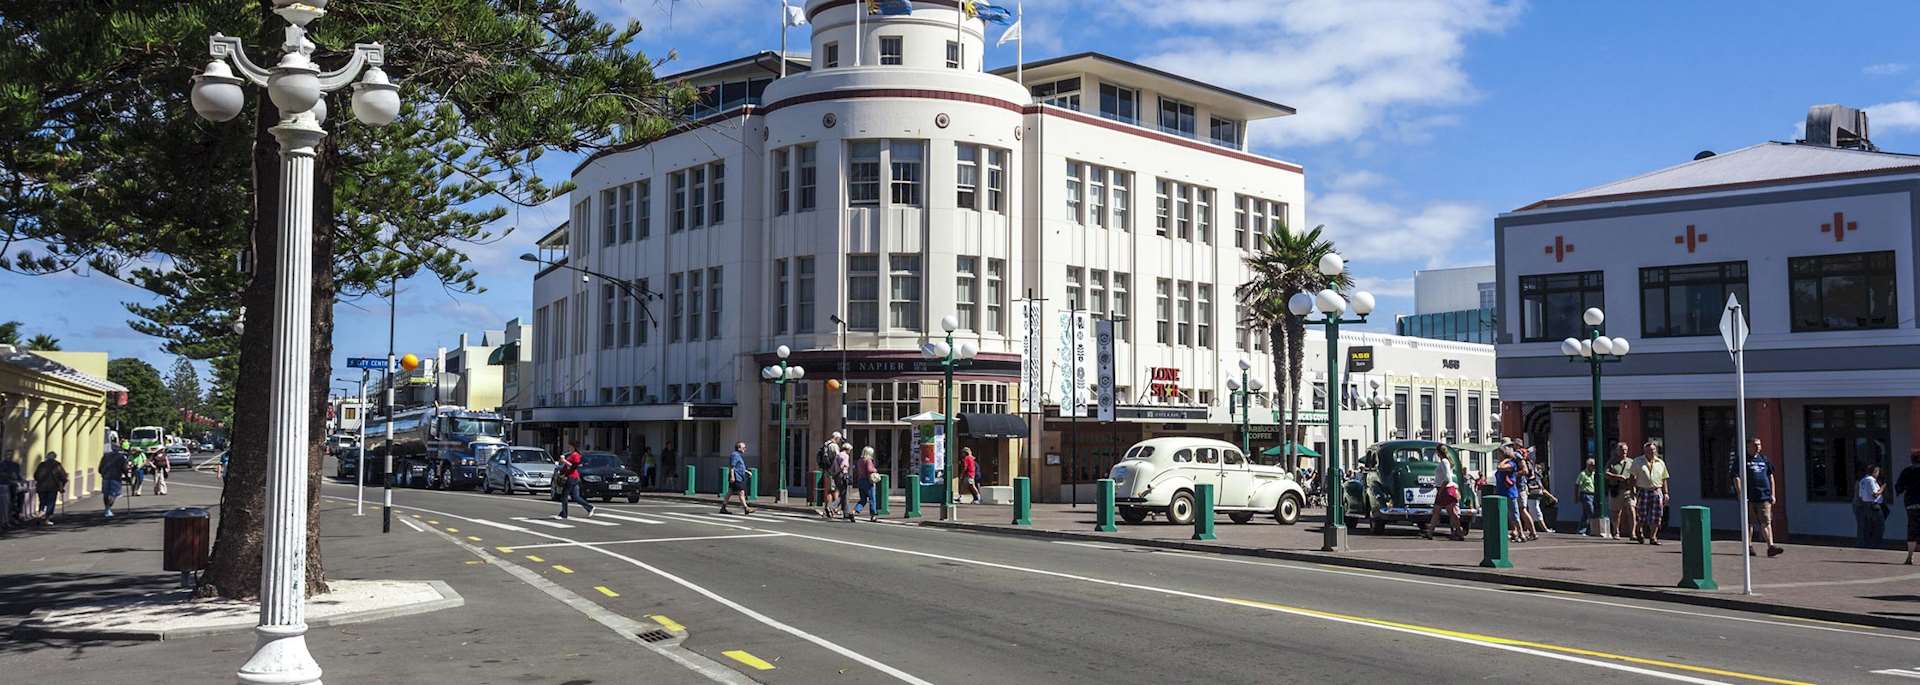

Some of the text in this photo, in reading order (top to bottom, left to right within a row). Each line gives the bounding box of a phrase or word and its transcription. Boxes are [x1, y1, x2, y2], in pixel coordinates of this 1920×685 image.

[859, 361, 905, 371] NAPIER
[1151, 367, 1180, 381] LONE
[1248, 432, 1273, 440] COFFEE
